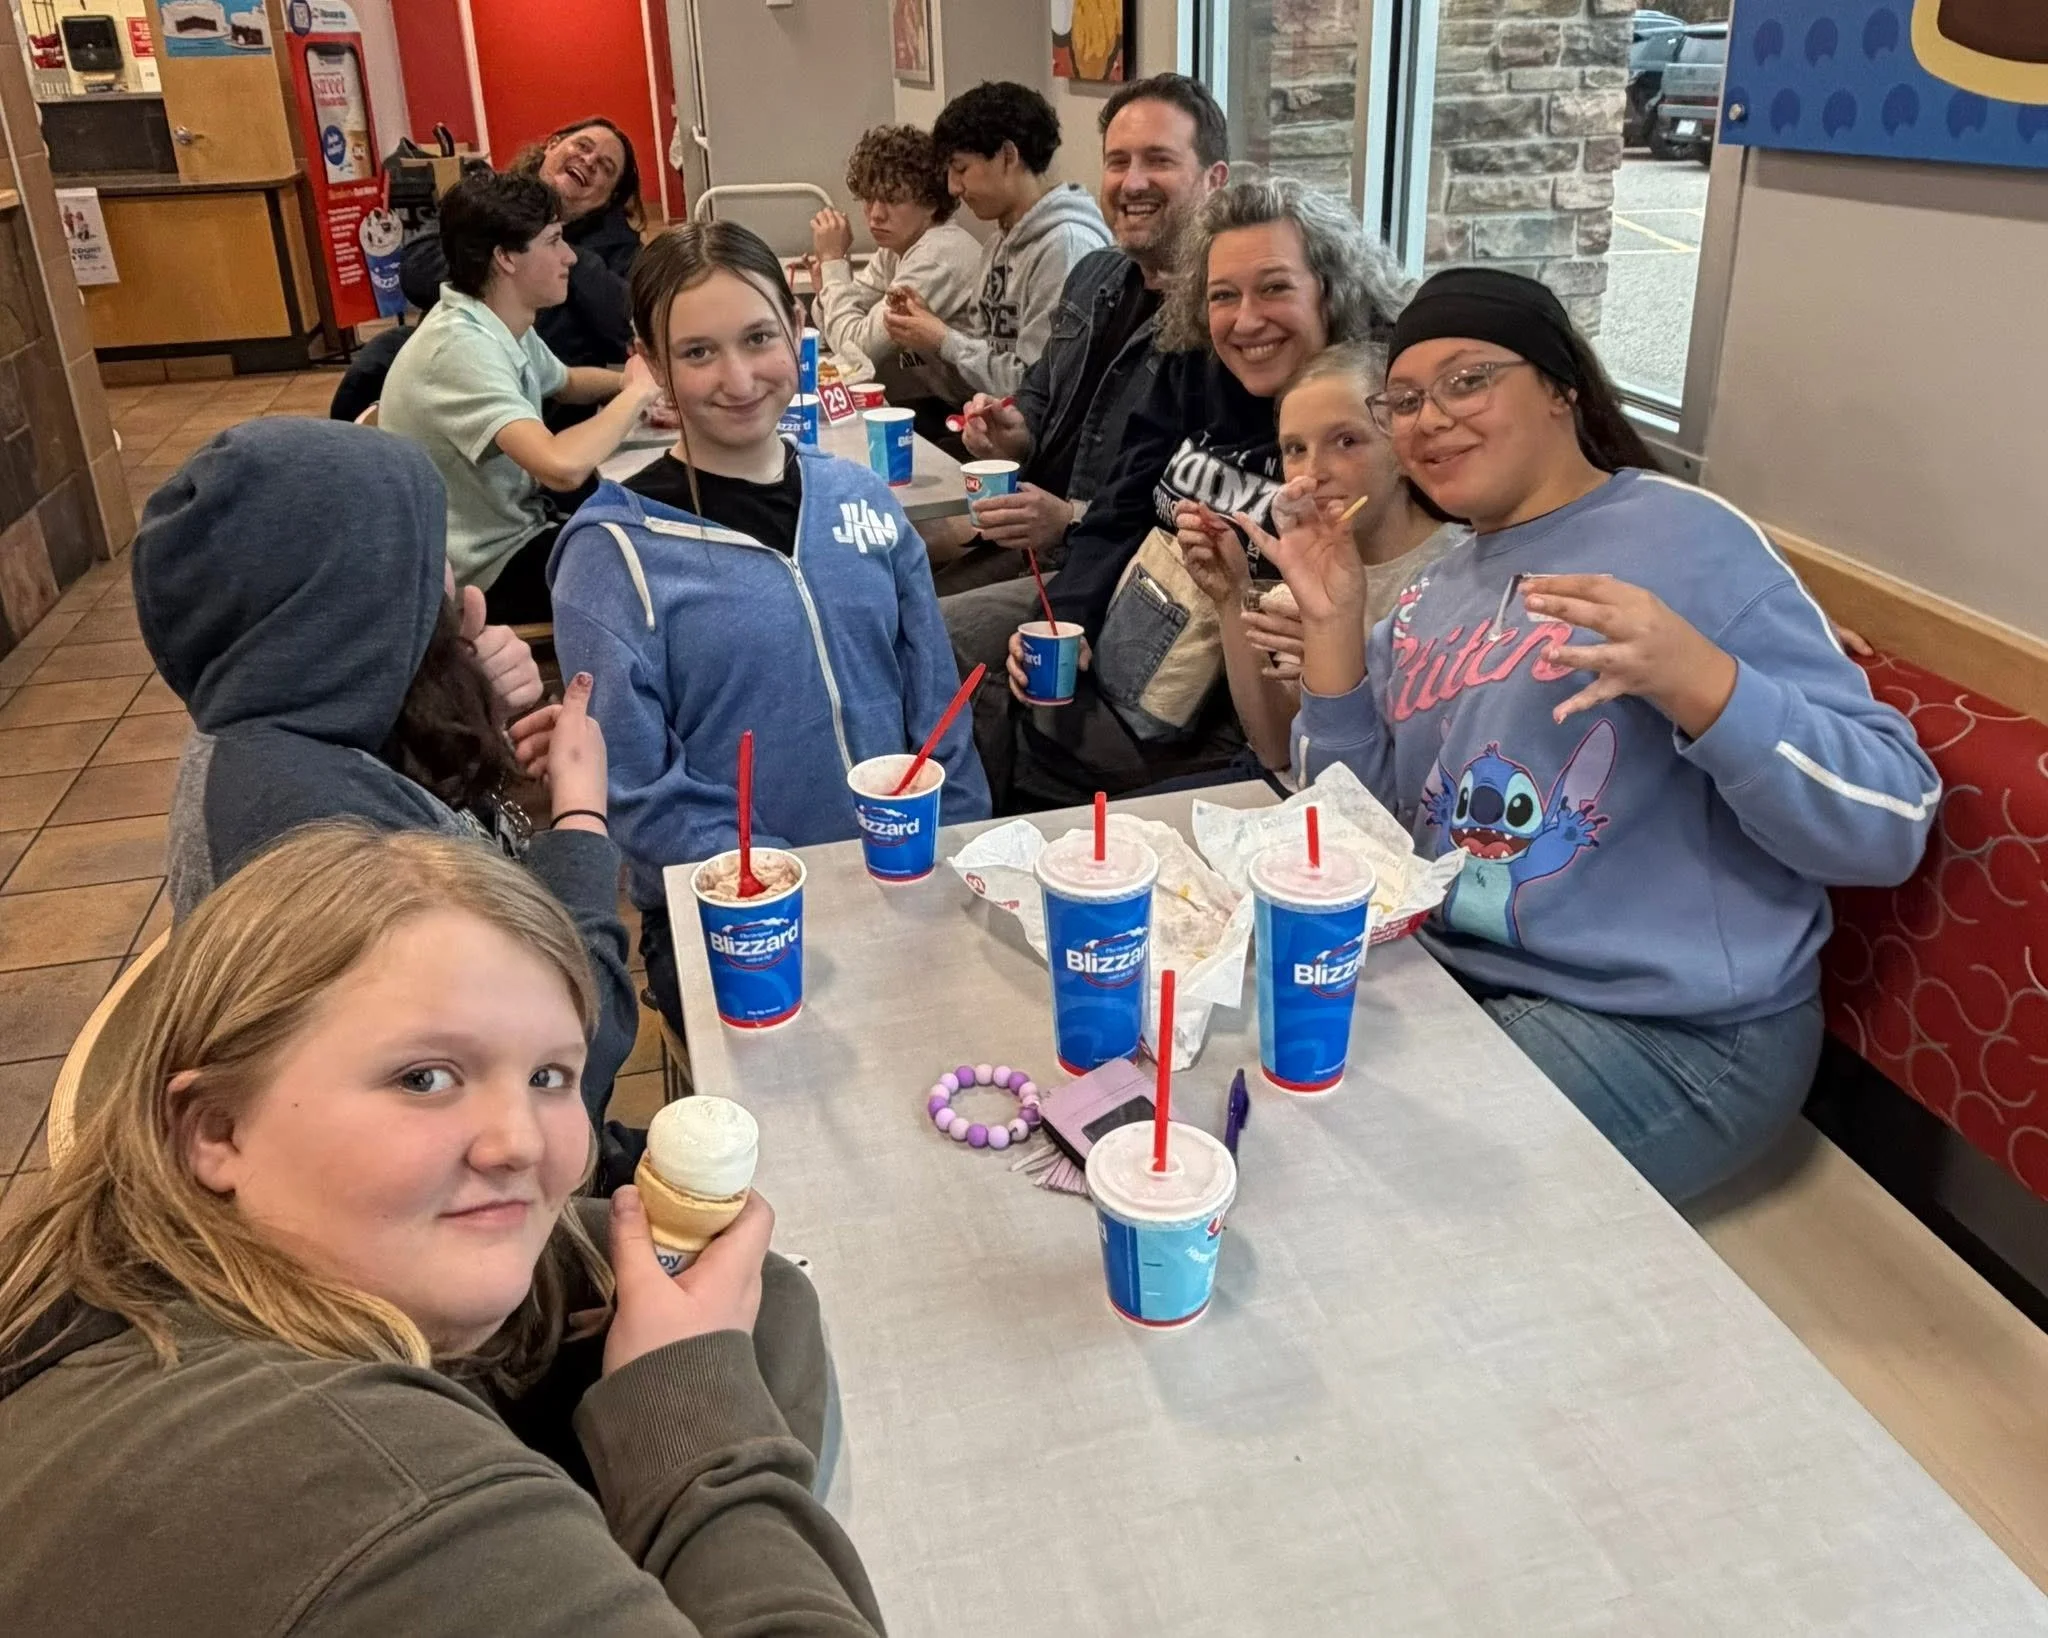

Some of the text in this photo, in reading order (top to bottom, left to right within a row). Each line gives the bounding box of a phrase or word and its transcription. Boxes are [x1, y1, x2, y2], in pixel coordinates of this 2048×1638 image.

[824, 386, 848, 414] 29
[857, 812, 920, 836] izzard
[709, 918, 799, 956] Blizzard
[1066, 935, 1149, 973] Blizzar
[1294, 957, 1358, 985] Blizz
